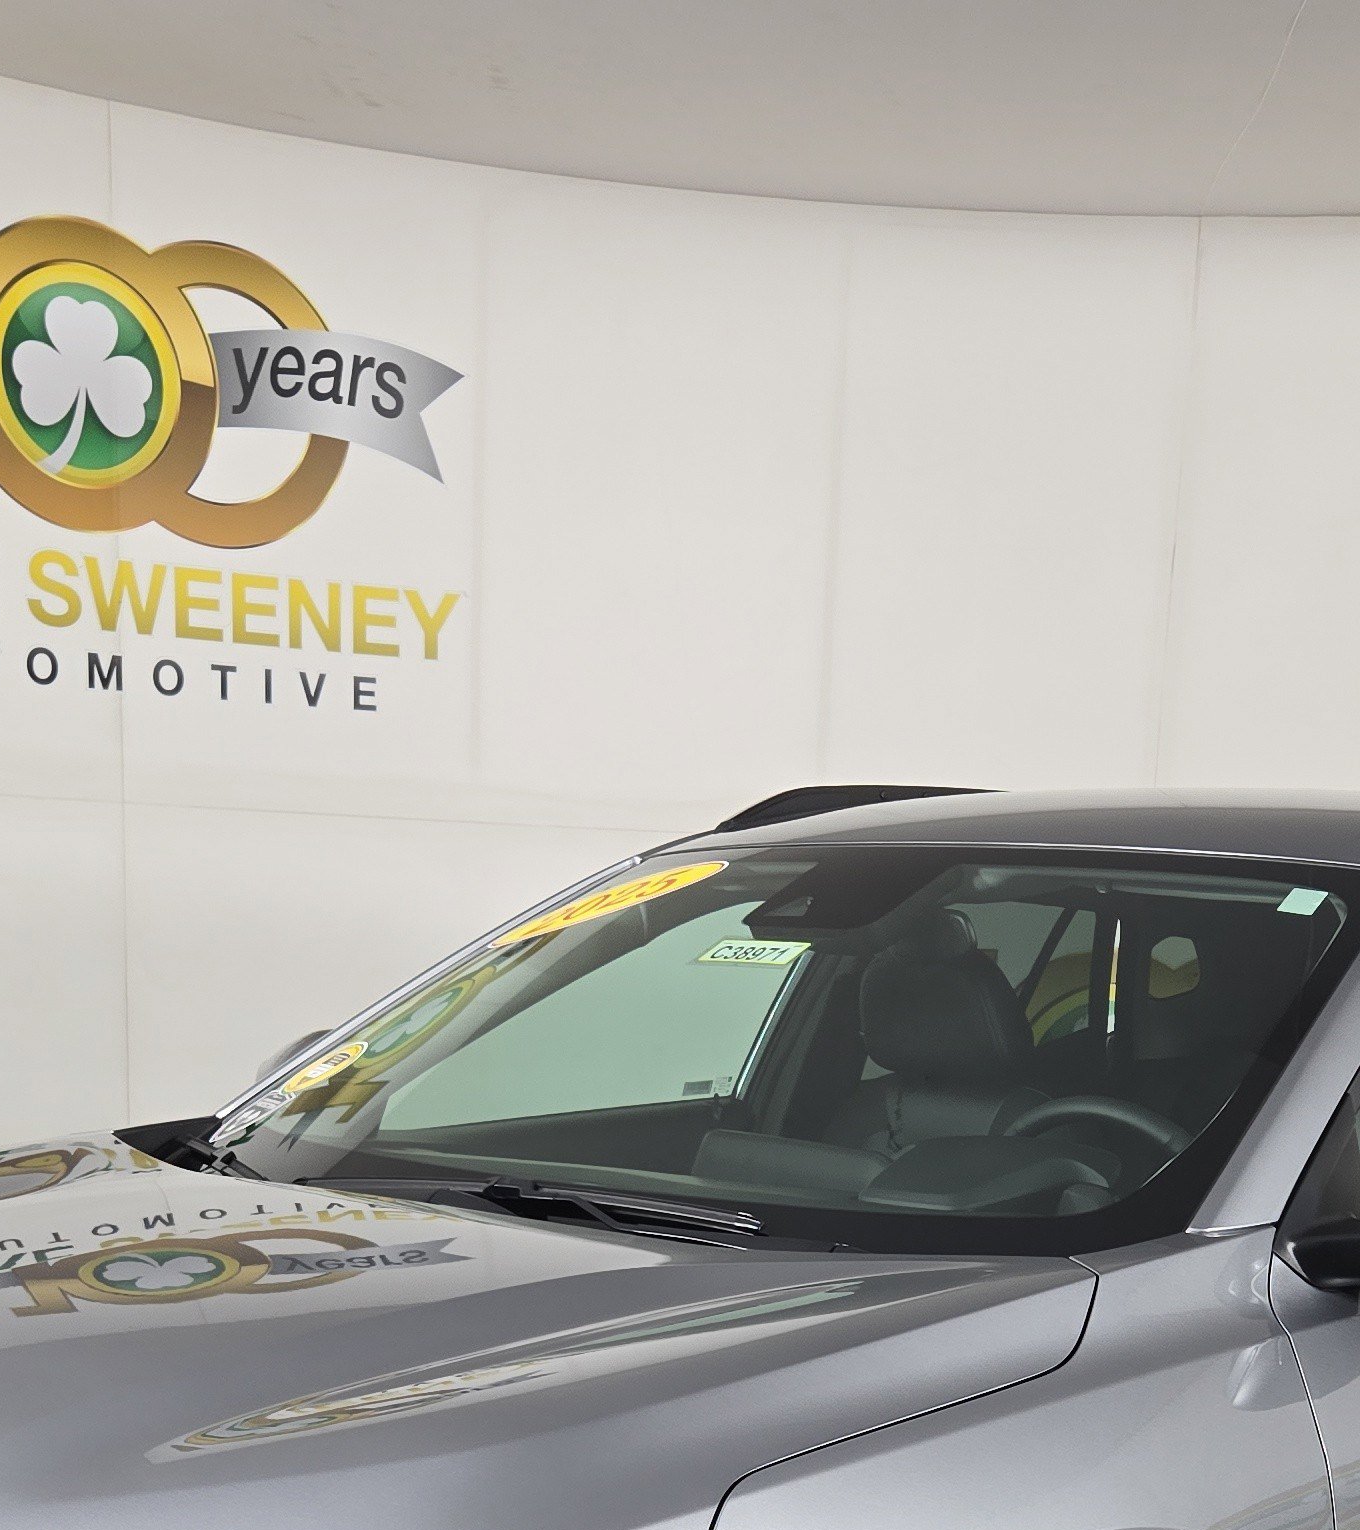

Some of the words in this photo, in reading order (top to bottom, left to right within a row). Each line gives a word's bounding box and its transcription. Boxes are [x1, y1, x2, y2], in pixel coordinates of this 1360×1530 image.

[231, 341, 409, 419] years
[26, 550, 462, 661] SWEENEY
[520, 868, 693, 937] 2025
[709, 945, 791, 961] C38971
